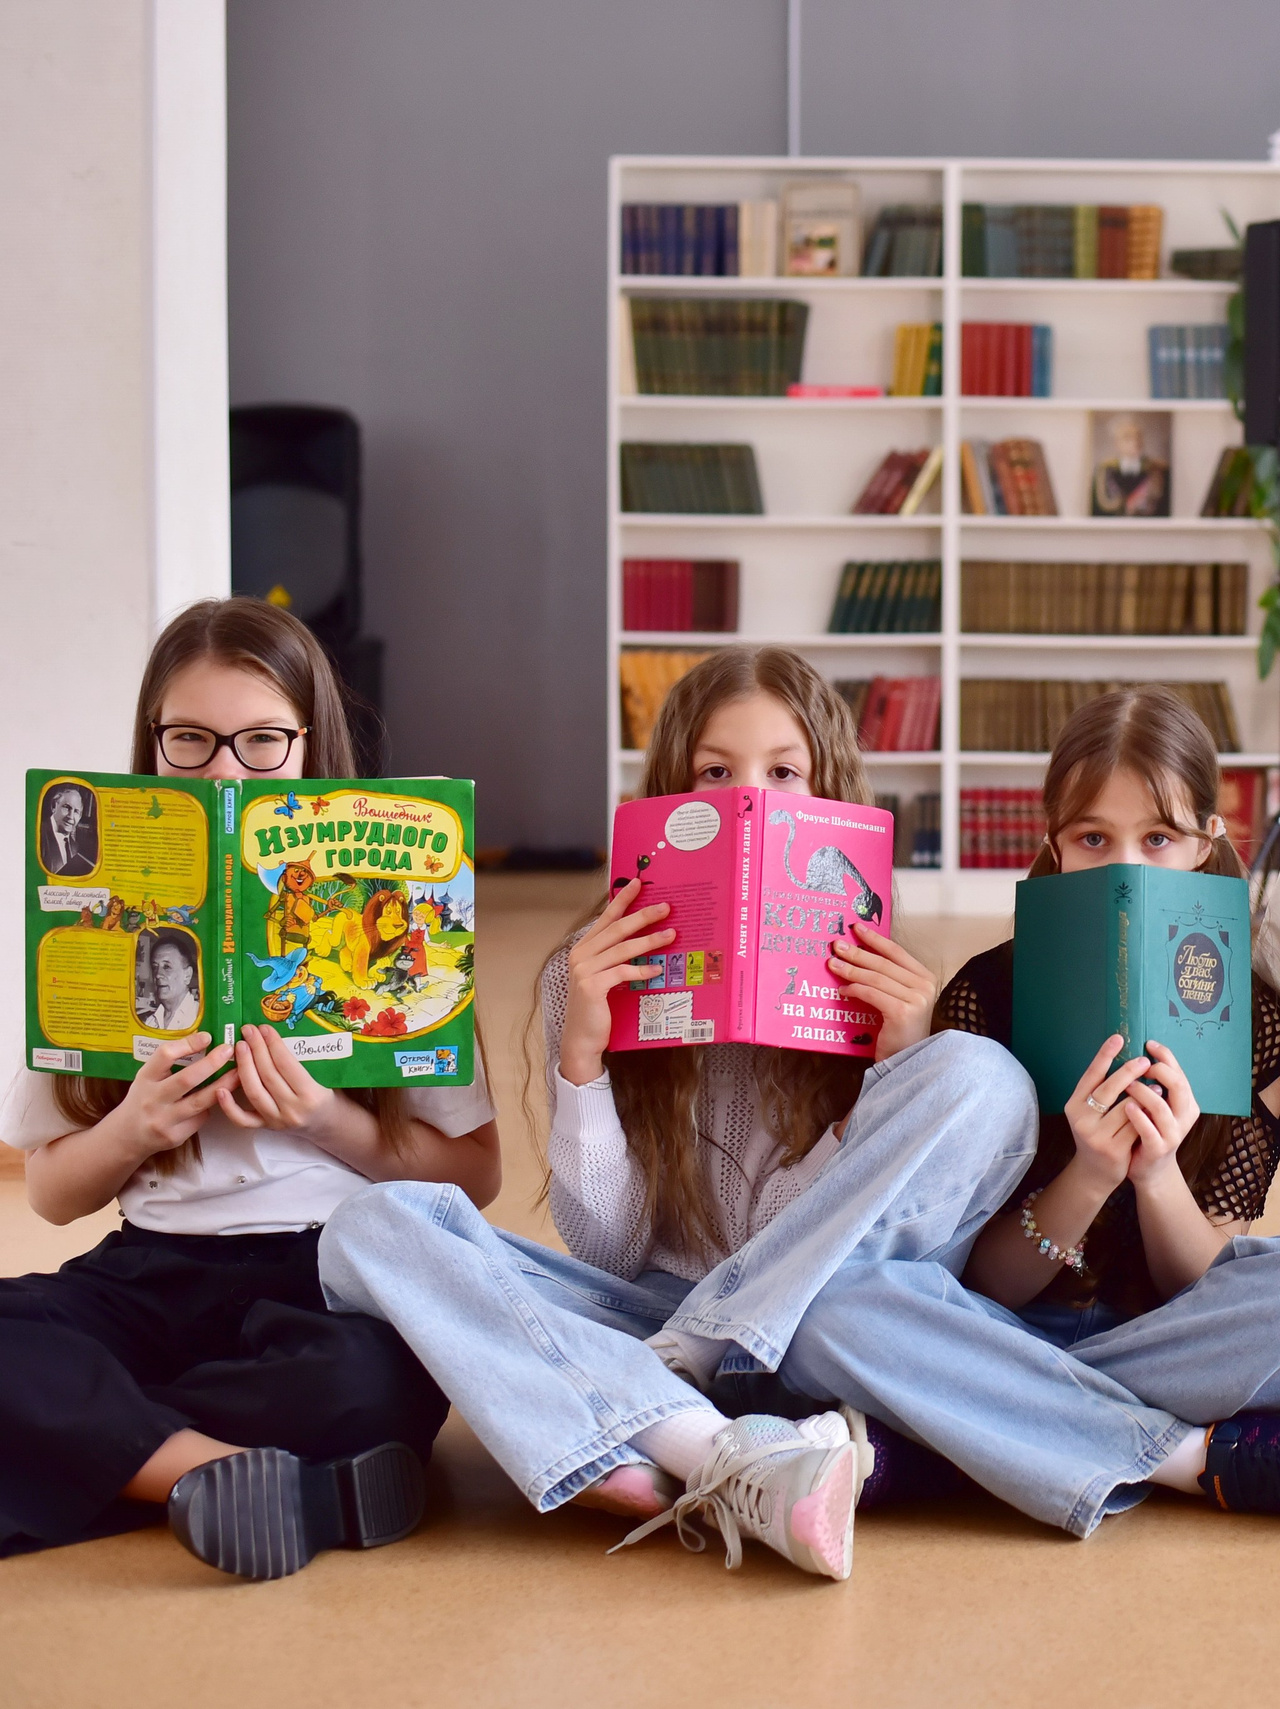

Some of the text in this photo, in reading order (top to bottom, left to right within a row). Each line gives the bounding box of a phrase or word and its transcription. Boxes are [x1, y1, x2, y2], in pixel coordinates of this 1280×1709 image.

[353, 797, 432, 824] Волшебник
[796, 810, 886, 833] Фрауке Шойнеманн
[254, 820, 448, 856] ИЗУМРУДНОГО
[743, 820, 751, 854] лапах
[225, 854, 233, 885] города
[325, 848, 412, 871] ГОРОДА
[742, 857, 750, 901] мягких
[44, 889, 70, 899] Александр
[66, 899, 82, 908] автор
[741, 907, 748, 921] на
[737, 924, 748, 958] Агент
[760, 933, 835, 958] детект
[1178, 945, 1217, 968] Люблю
[222, 958, 234, 1004] Волшебник
[1181, 966, 1190, 976] я
[1179, 975, 1216, 992] богини
[1182, 990, 1212, 1004] пенья
[782, 1003, 877, 1025] на мягких
[792, 1025, 846, 1043] лапах
[294, 1039, 344, 1056] Волков
